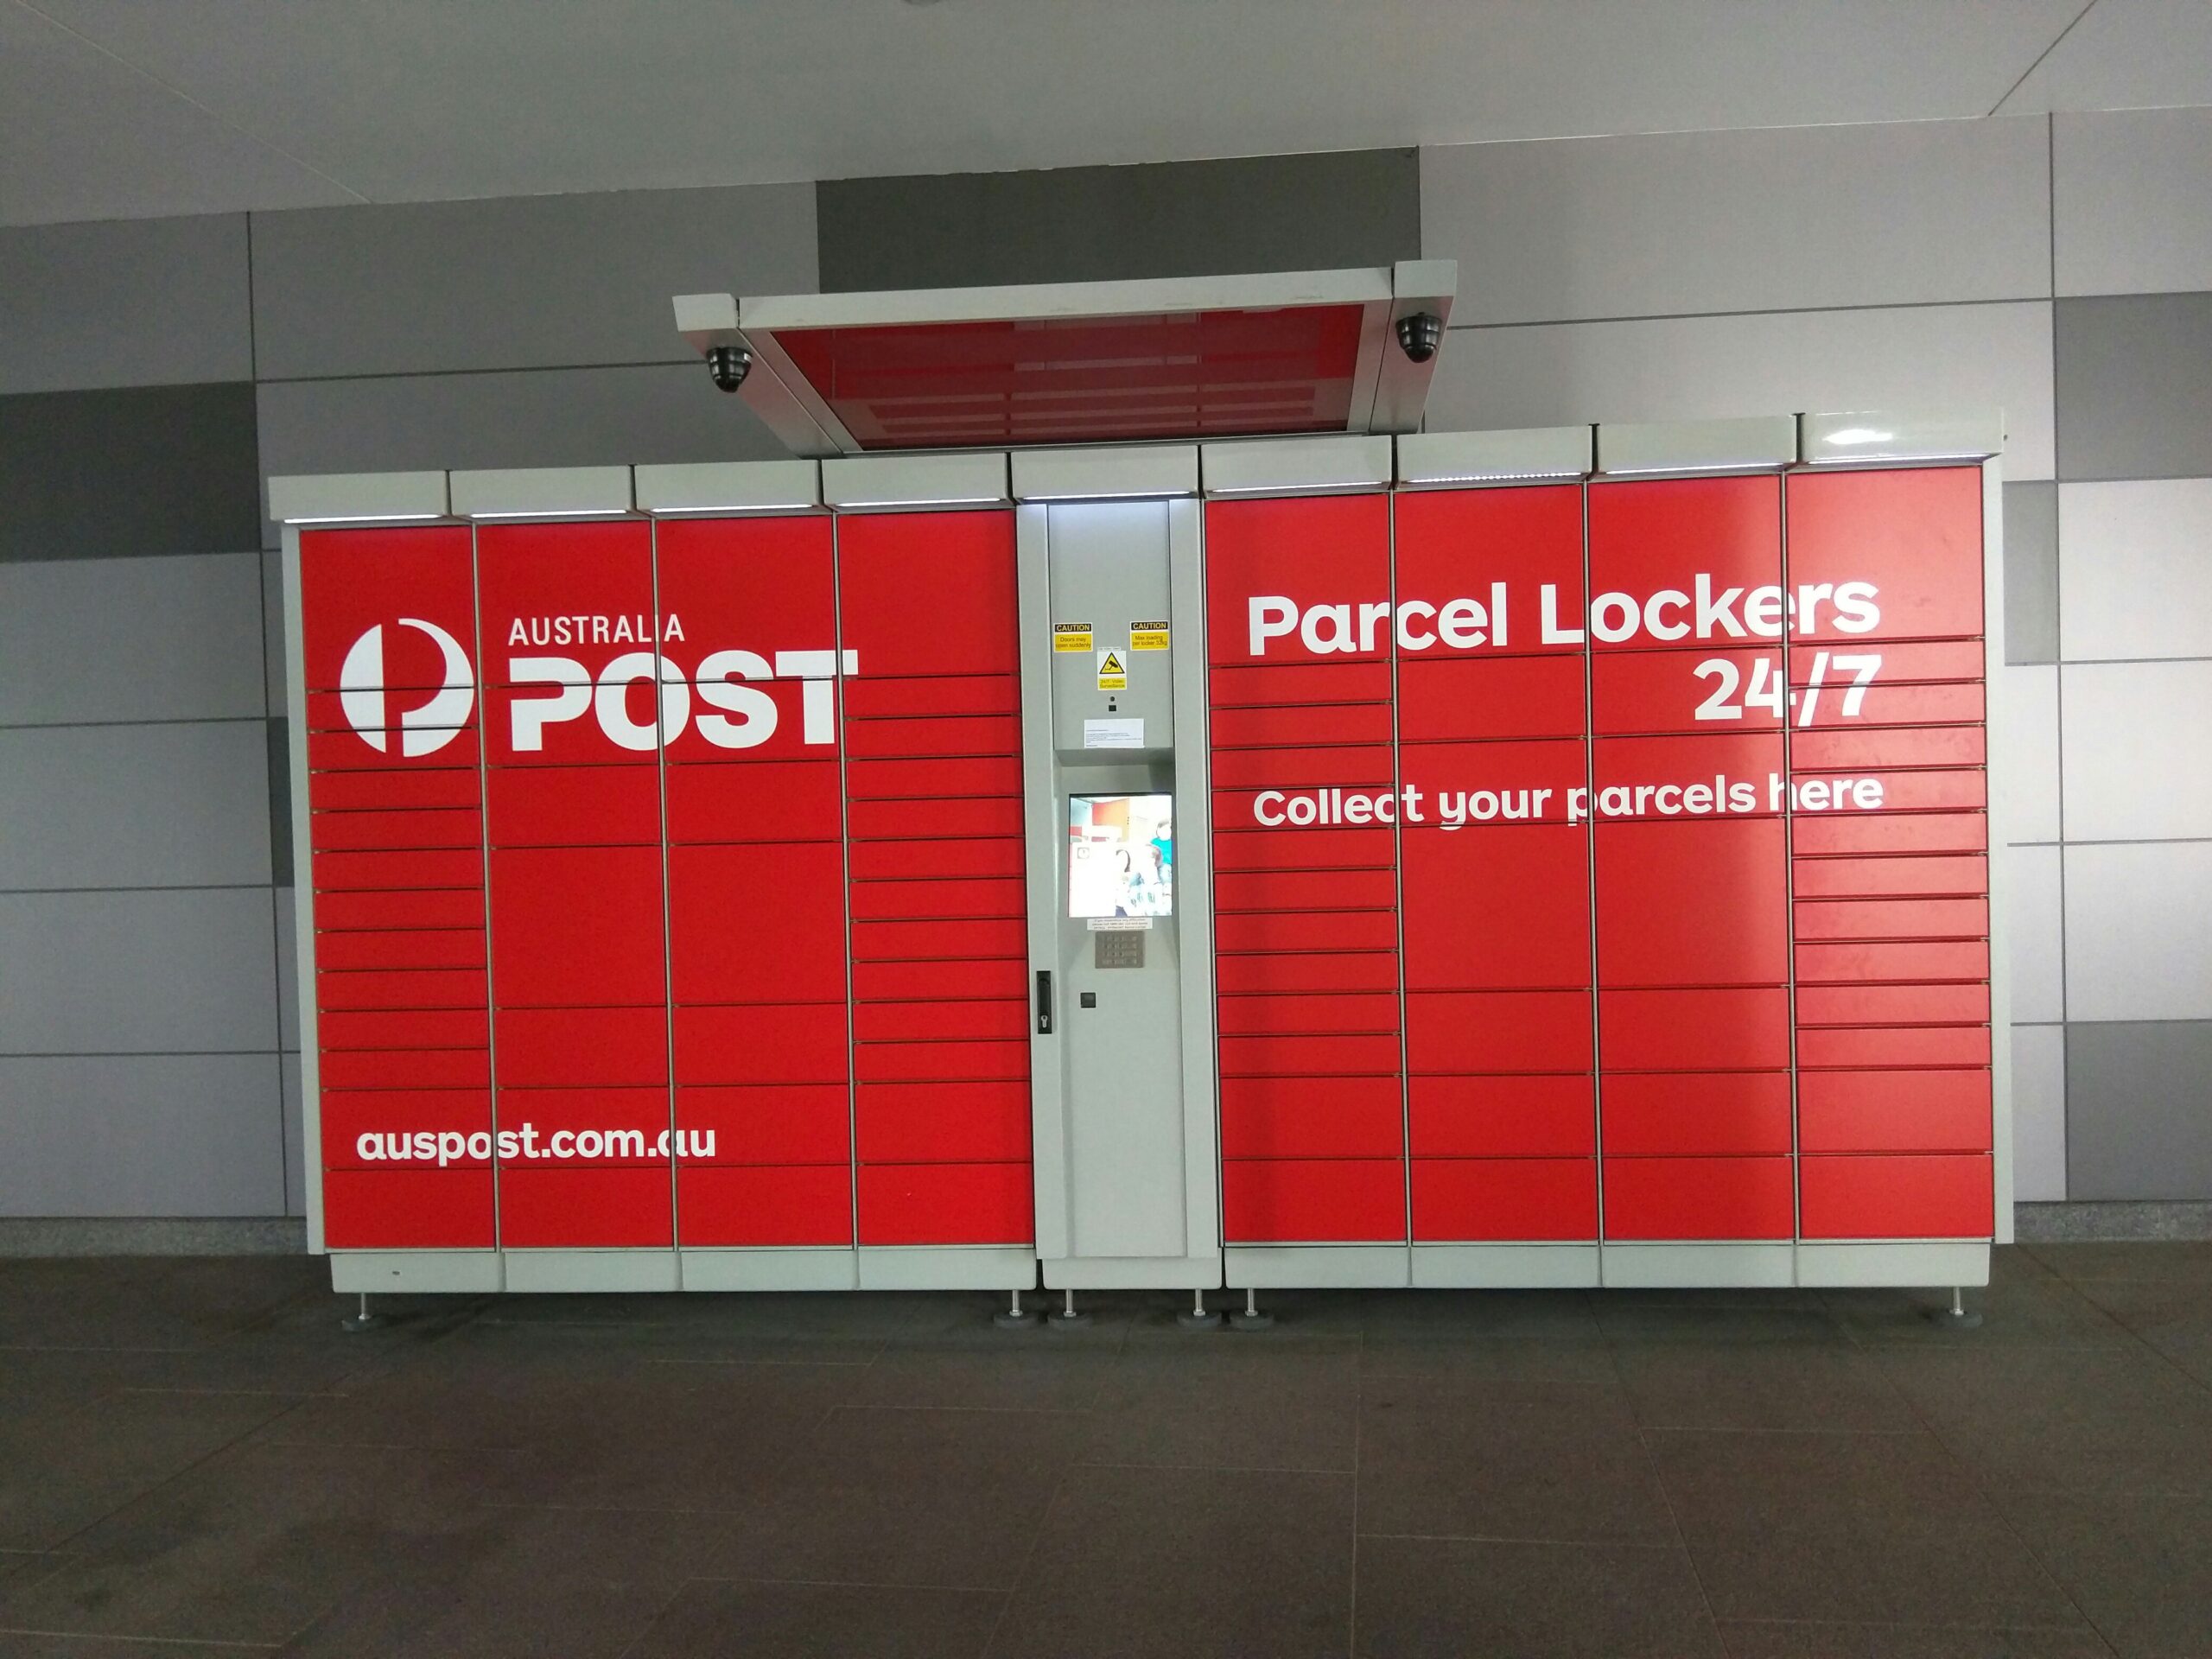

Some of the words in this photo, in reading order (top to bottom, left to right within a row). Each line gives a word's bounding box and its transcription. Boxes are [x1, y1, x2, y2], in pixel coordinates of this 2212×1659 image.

[508, 613, 685, 646] AUSTRALIA
[1249, 582, 1507, 656] Parcel
[1541, 573, 1881, 645] Lockers
[509, 649, 859, 752] POST
[1694, 652, 1882, 727] 24/7
[1253, 785, 1425, 827] Collect
[1439, 788, 1553, 830] your
[1567, 774, 1756, 826] parcels
[1768, 773, 1885, 812] here
[356, 1122, 717, 1167] auspost.com.au
